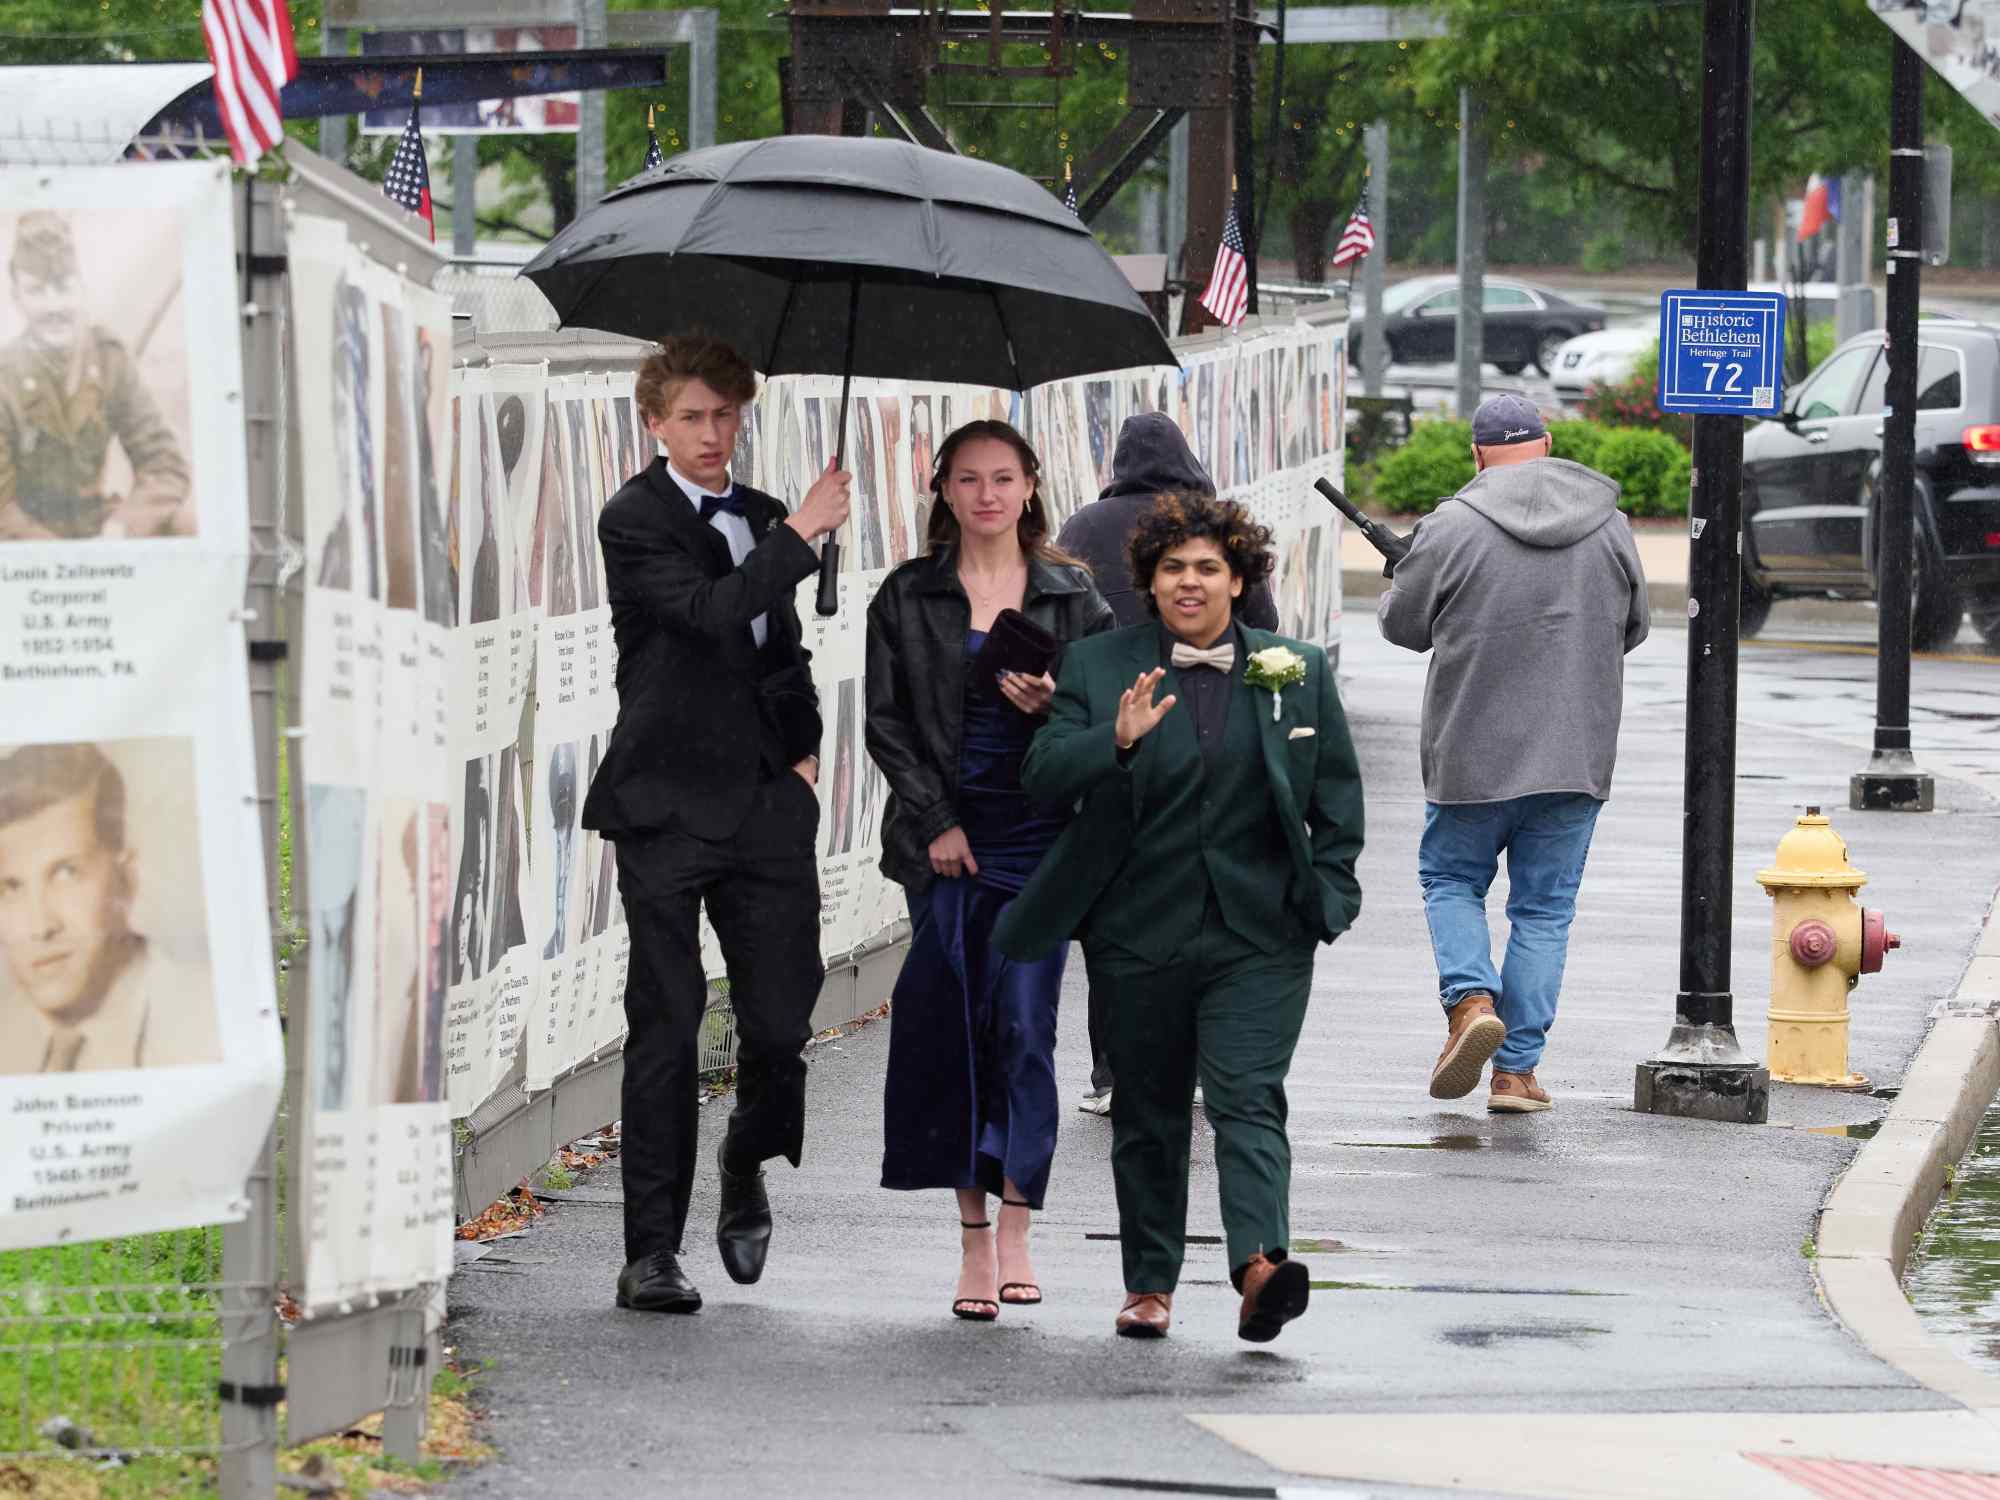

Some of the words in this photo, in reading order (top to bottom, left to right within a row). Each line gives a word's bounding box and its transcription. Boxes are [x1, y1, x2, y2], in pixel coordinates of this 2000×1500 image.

[1694, 312, 1754, 329] Historic
[1682, 328, 1761, 344] Bethlehem
[1690, 348, 1727, 359] Heritage
[1732, 349, 1751, 359] Trail
[1702, 362, 1743, 392] 72
[29, 588, 107, 607] Corporal
[66, 613, 112, 632] Army
[12, 1098, 58, 1114] John
[42, 1119, 115, 1135] Private
[81, 1143, 132, 1160] Army
